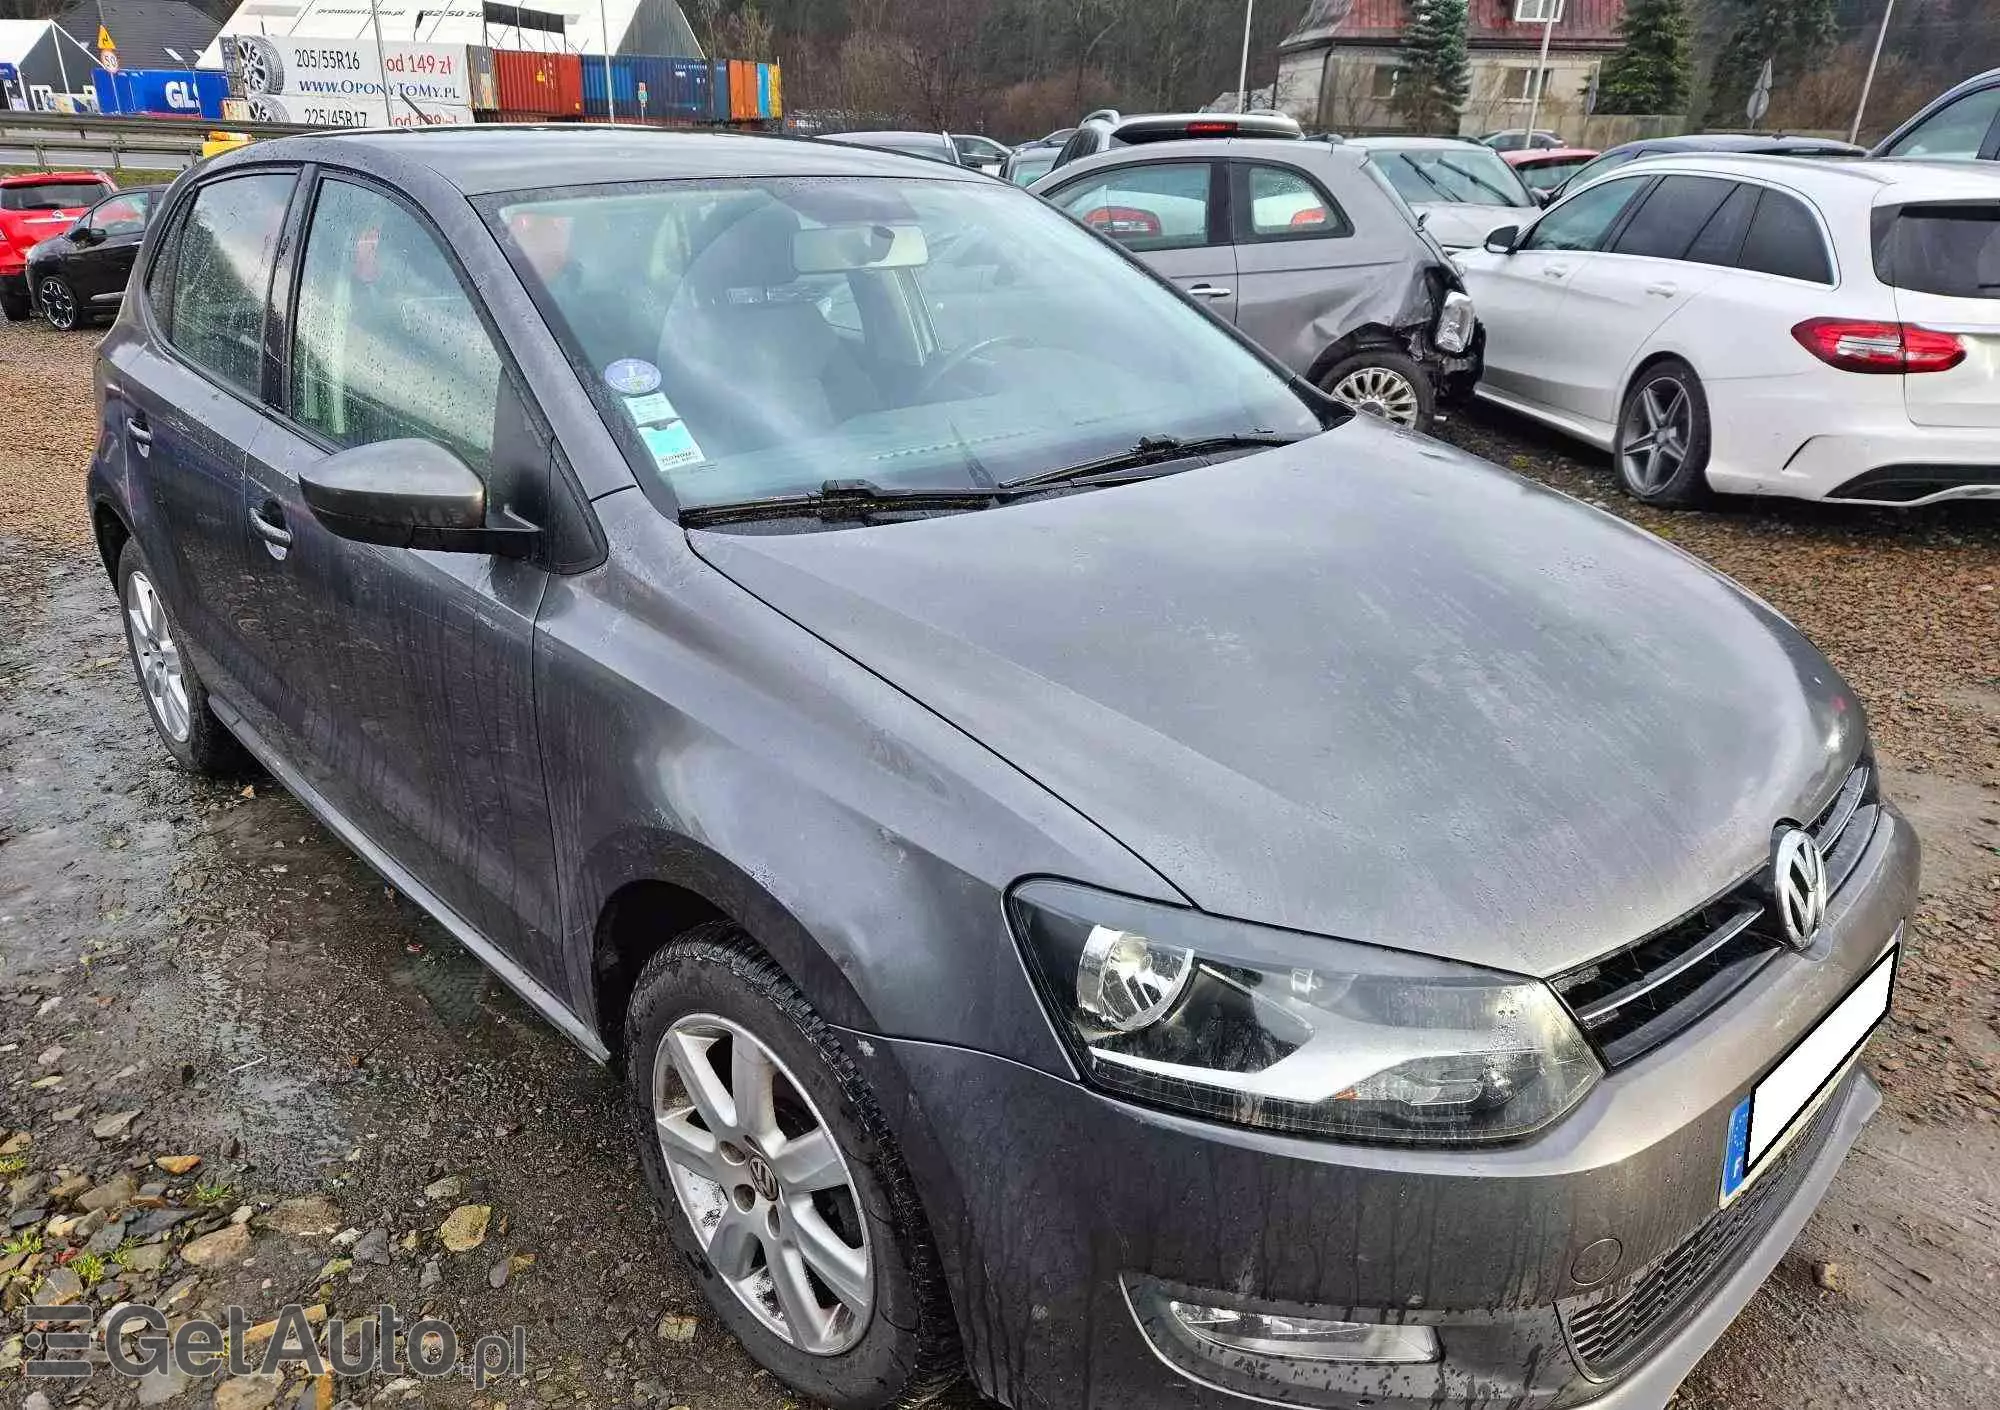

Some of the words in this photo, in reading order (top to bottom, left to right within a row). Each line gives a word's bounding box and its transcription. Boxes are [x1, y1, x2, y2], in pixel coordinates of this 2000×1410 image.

[294, 49, 361, 71] 205/55R16
[386, 53, 405, 73] od
[407, 54, 436, 74] 149
[438, 55, 453, 76] zł
[304, 108, 368, 128] 225/45R17
